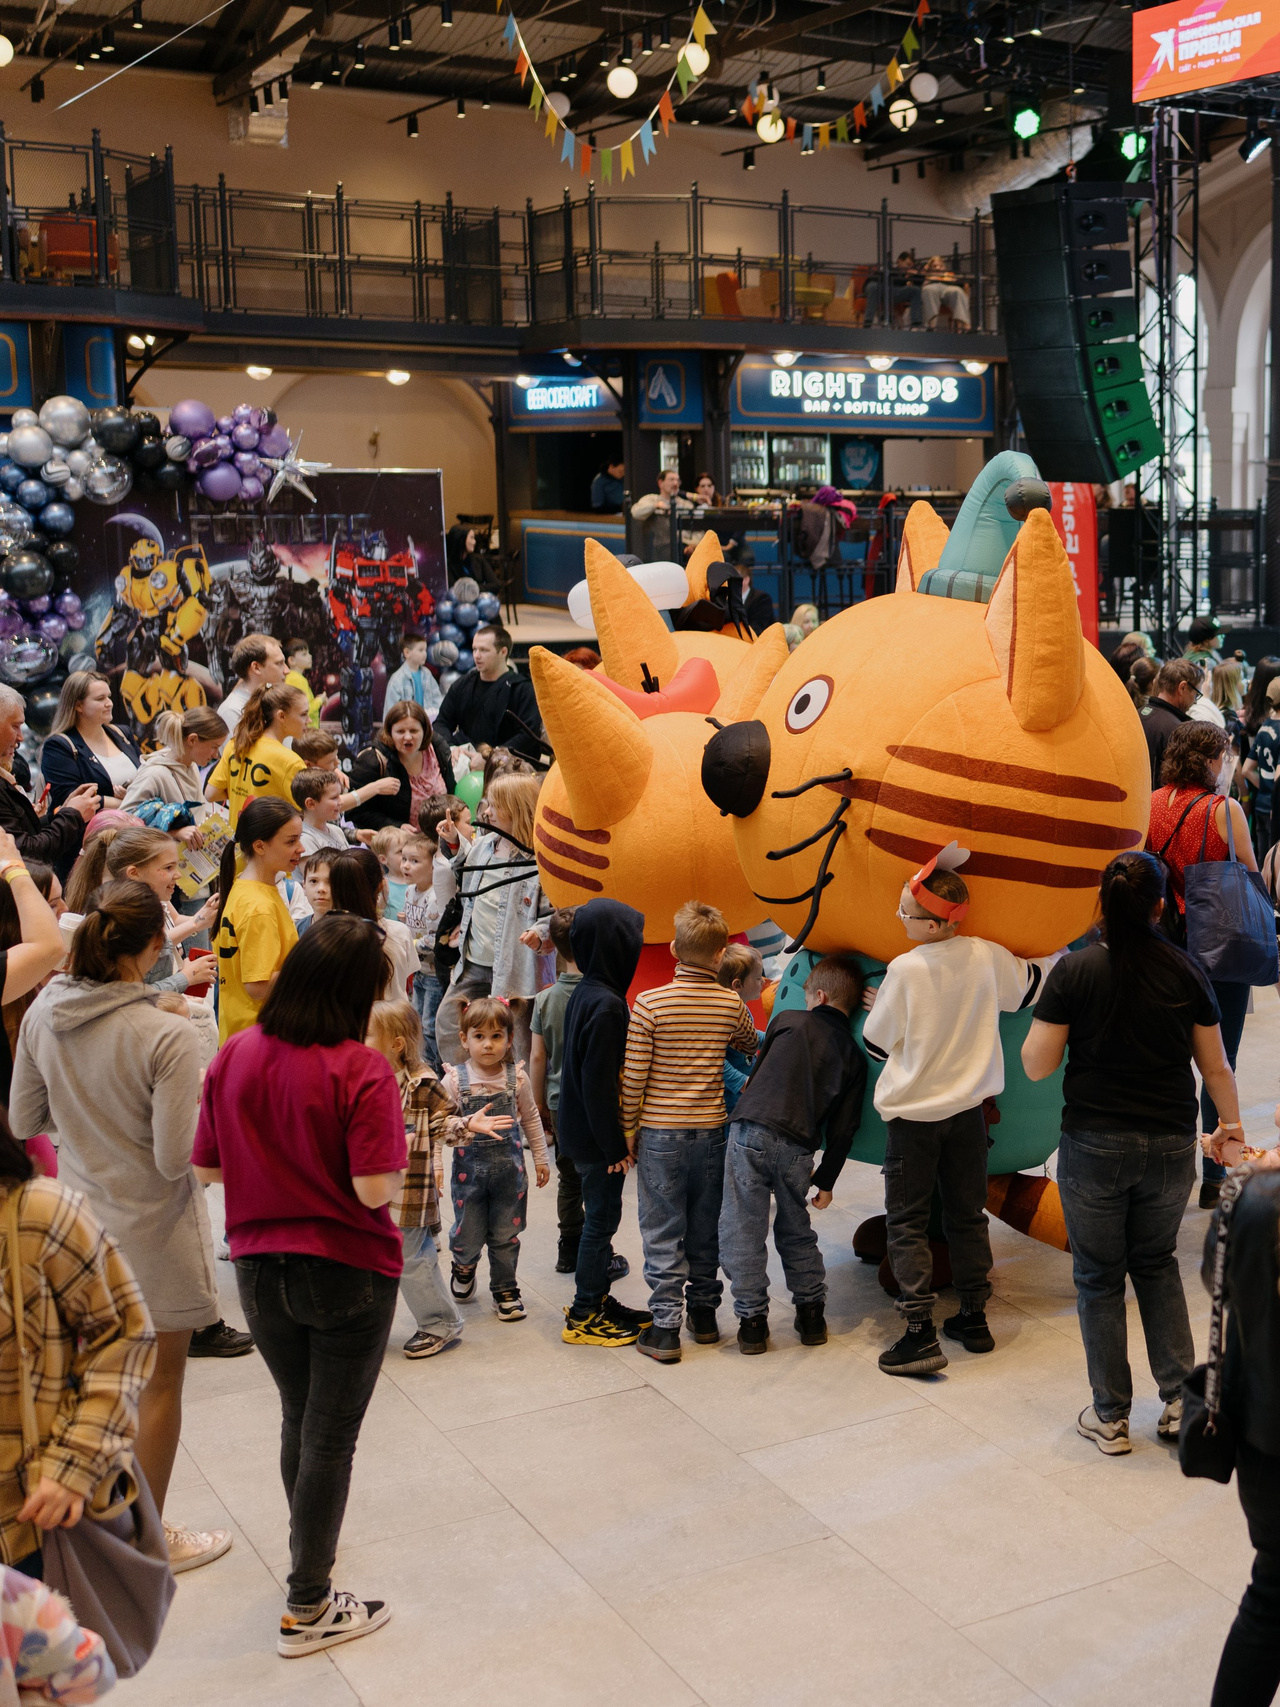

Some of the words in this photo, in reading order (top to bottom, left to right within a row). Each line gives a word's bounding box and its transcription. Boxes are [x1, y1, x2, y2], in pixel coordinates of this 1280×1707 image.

[1178, 29, 1242, 61] ПРАВДА
[771, 369, 866, 399] RIGHT
[877, 374, 959, 402] HOPS
[803, 399, 830, 413] BAR
[843, 401, 892, 415] BOTTLE
[894, 403, 929, 416] SHOP
